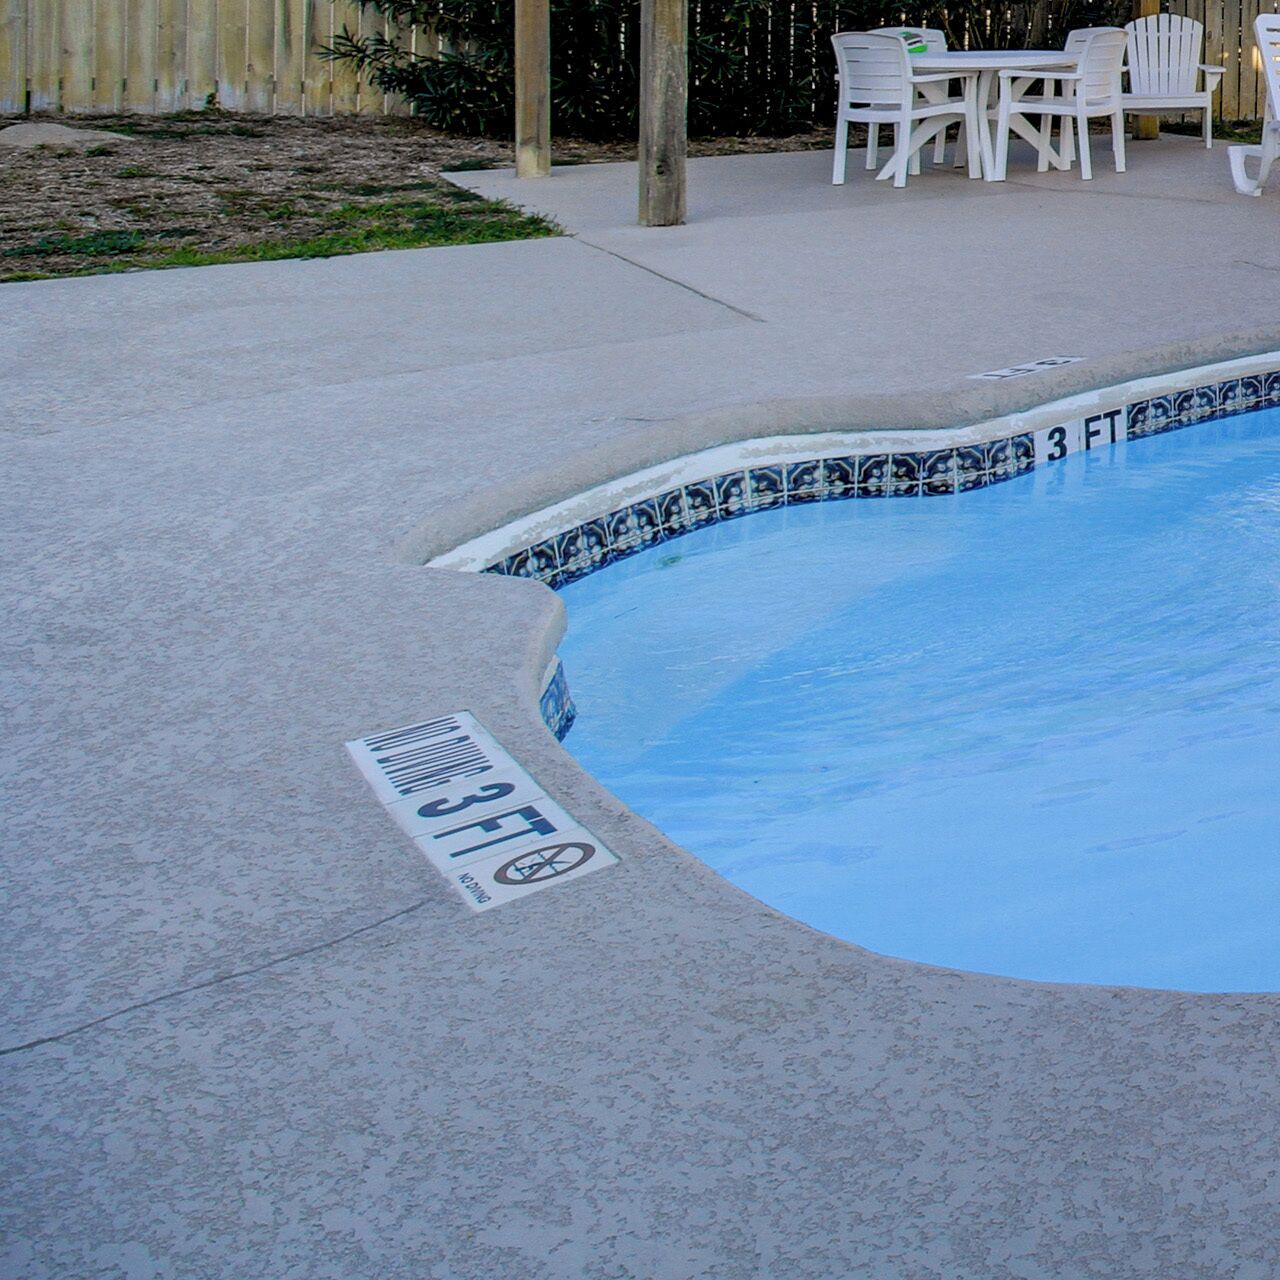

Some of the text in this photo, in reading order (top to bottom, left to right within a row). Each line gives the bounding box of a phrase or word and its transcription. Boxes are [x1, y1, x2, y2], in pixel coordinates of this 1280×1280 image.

[1047, 409, 1123, 461] 3 FT
[363, 716, 558, 859] NO DIVING 3 FT
[457, 872, 492, 904] NO DIVING
